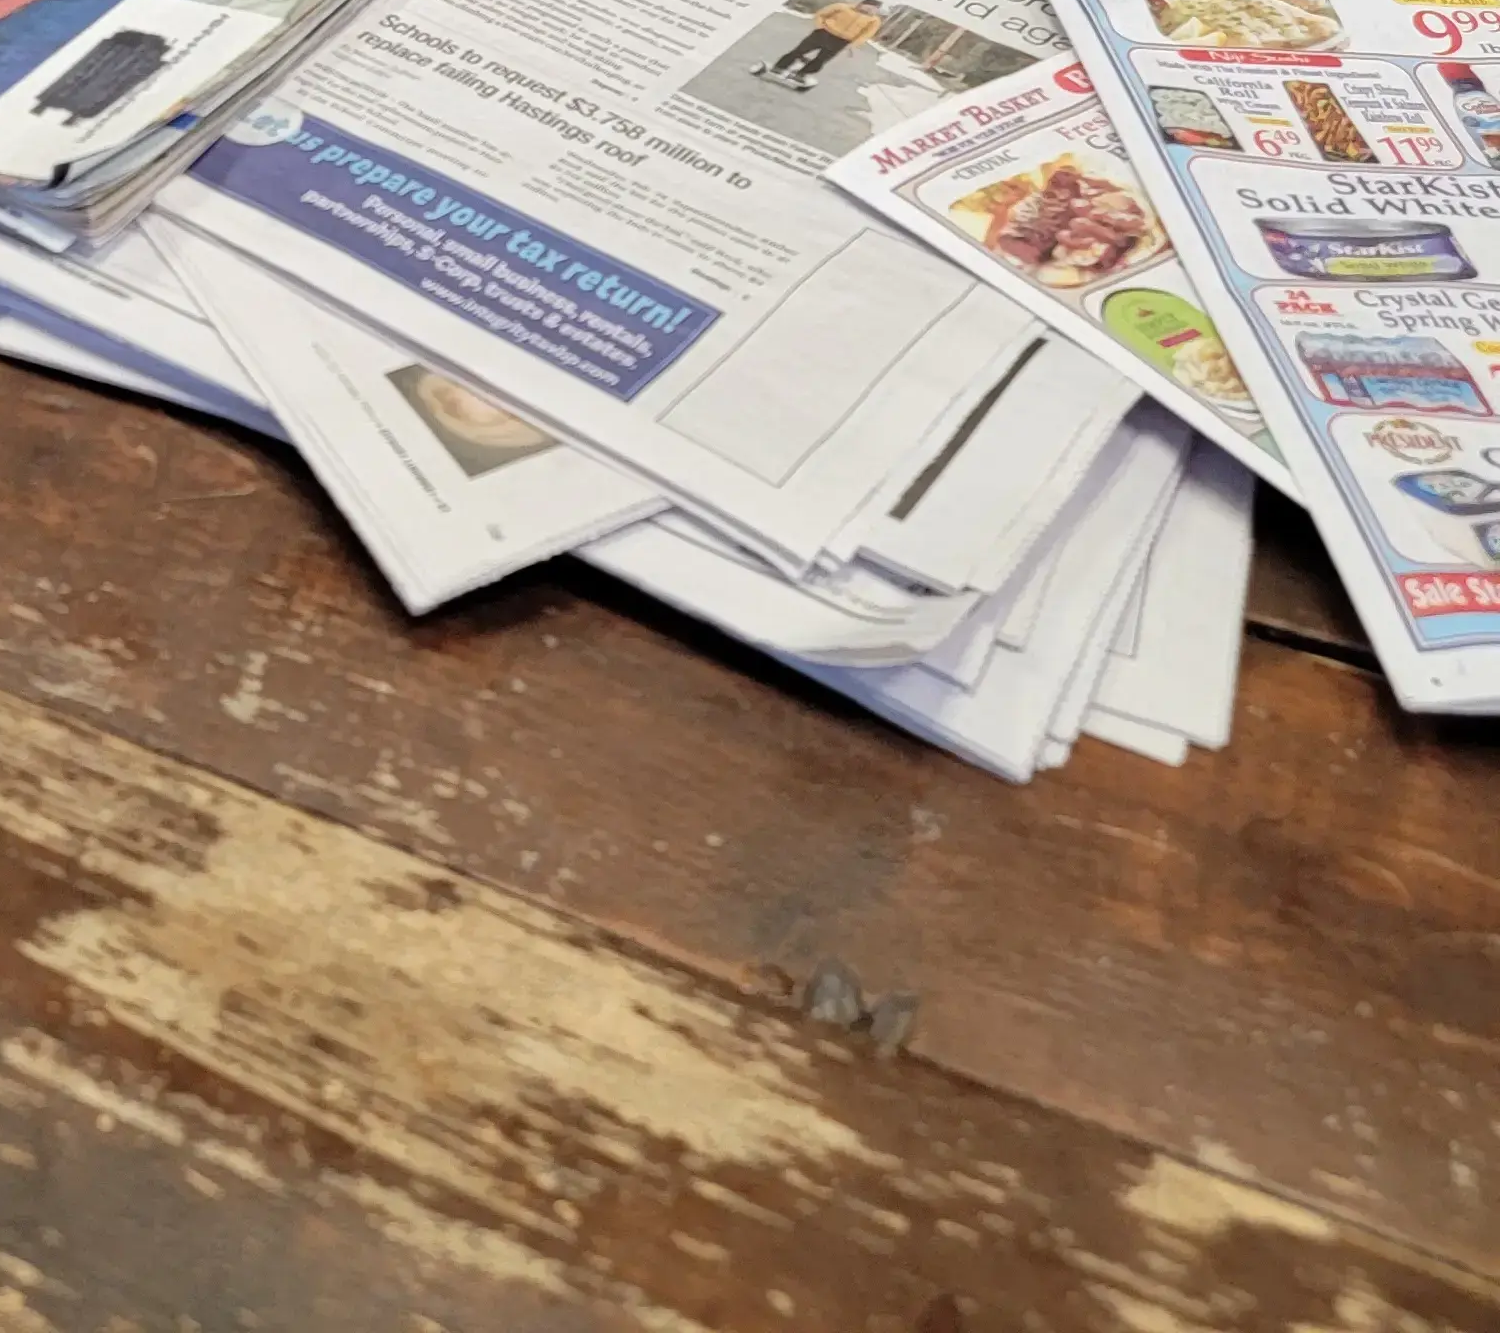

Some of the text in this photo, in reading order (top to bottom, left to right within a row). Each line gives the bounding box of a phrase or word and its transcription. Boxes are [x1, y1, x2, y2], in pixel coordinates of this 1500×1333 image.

[1192, 75, 1274, 91] California
[1218, 86, 1260, 101] Roll
[355, 27, 652, 172] replace failing Hastings roof
[378, 12, 457, 67] Schools
[459, 47, 483, 74] to
[484, 58, 565, 107] request
[564, 93, 648, 145] $3.758
[644, 131, 726, 181] million
[724, 166, 754, 193] to
[869, 86, 1052, 176] MARKET BASKET
[1235, 188, 1358, 216] Solid
[285, 130, 325, 152] us
[309, 138, 437, 206] prepare
[423, 195, 512, 242] your
[505, 228, 570, 273] tax
[559, 256, 694, 335] return!
[441, 237, 500, 273] small
[1325, 241, 1425, 258] StarKist
[1284, 289, 1312, 301] 24
[1352, 289, 1456, 313] Crystal
[542, 311, 562, 330] &
[1274, 301, 1339, 315] PACK
[1375, 309, 1481, 336] Spring
[1363, 430, 1466, 454] PRESIDENT
[1403, 575, 1463, 609] Sale
